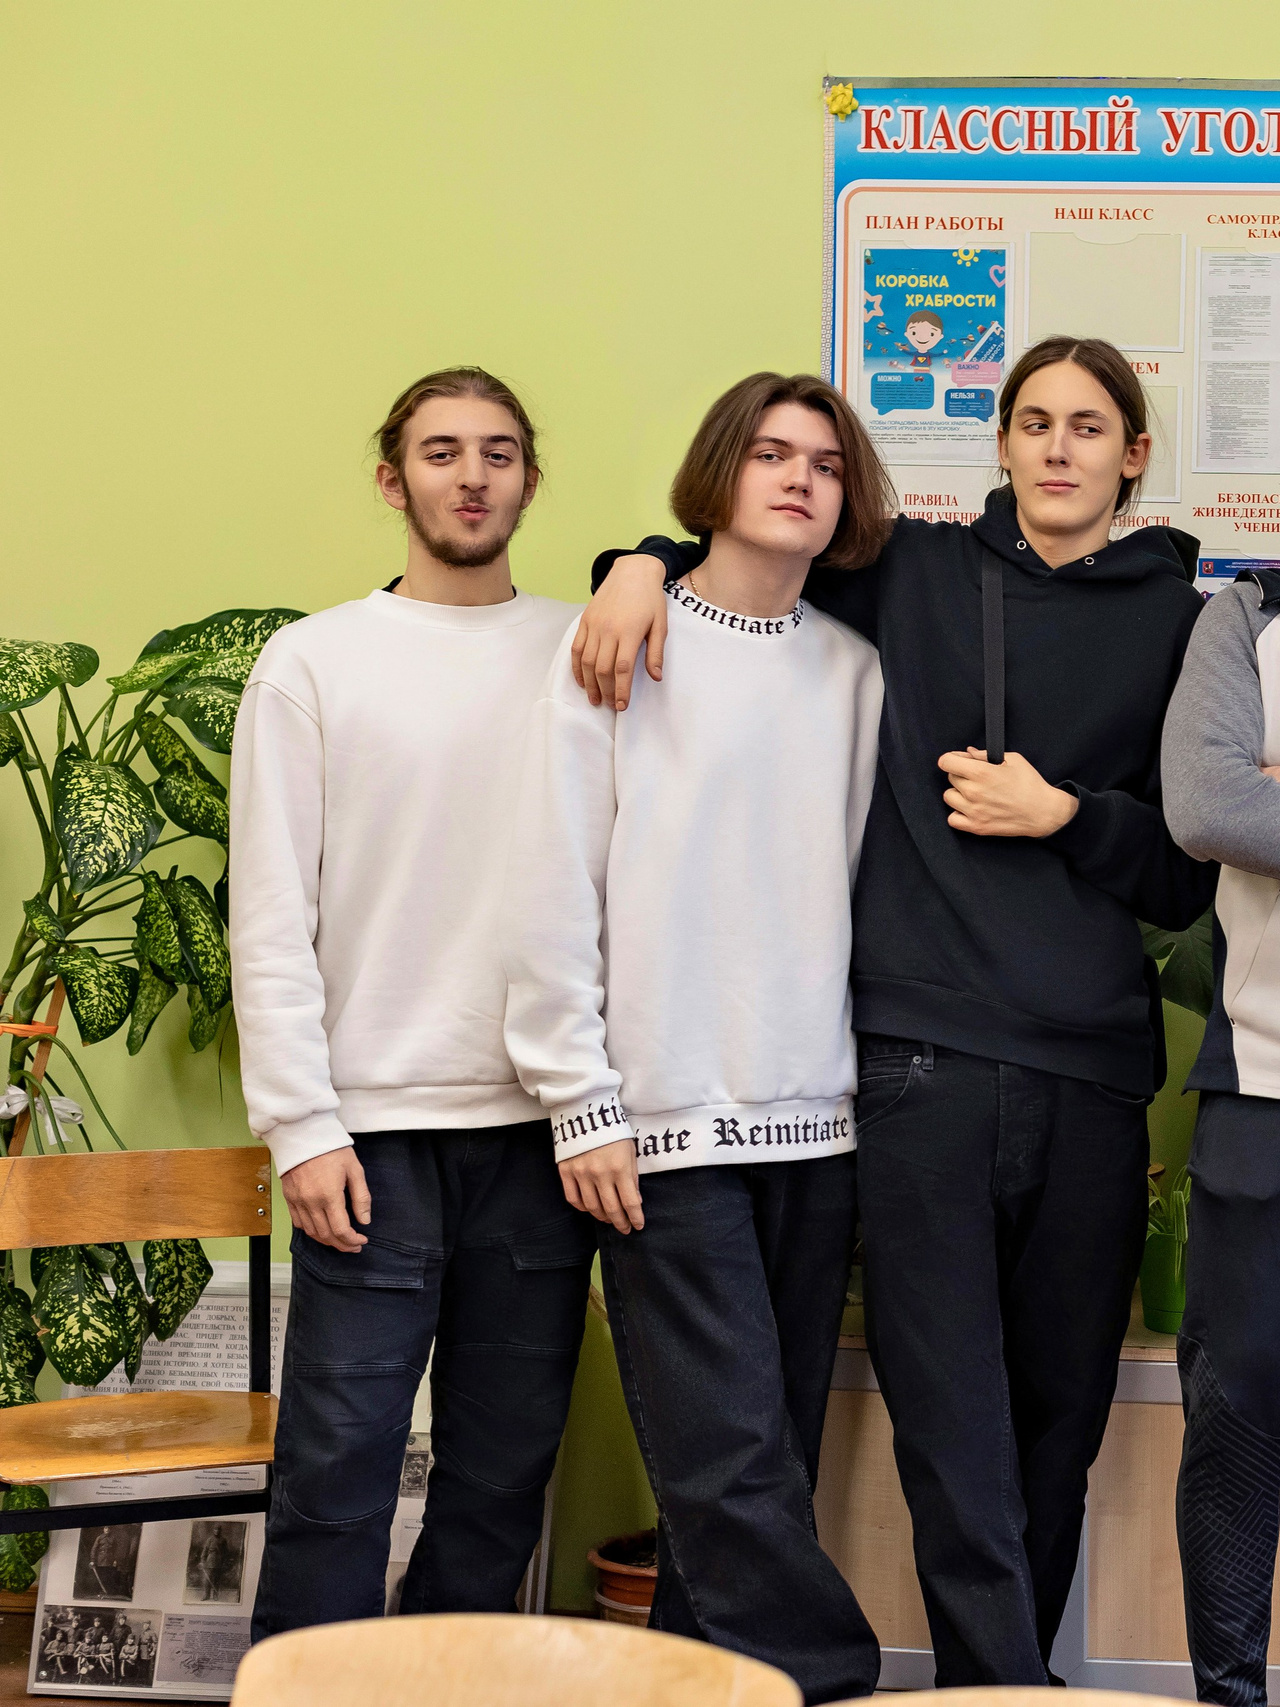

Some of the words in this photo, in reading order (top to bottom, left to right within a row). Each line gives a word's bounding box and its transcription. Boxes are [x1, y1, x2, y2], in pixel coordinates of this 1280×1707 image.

[860, 97, 1139, 152] КЛАССНЫЙ
[1054, 207, 1094, 220] НАШ
[1099, 208, 1154, 220] КЛАСС
[865, 215, 919, 230] ПЛАН
[924, 216, 1004, 231] РАБОТЫ
[876, 274, 949, 288] КОРОБКА
[905, 294, 996, 307] ХРАБРОСТИ
[904, 494, 958, 506] ПРАВИЛА
[662, 580, 785, 635] Reinitiate
[712, 1114, 850, 1148] Reinitiate
[182, 1322, 235, 1330] ВИДЕТЕЛЬСТВА
